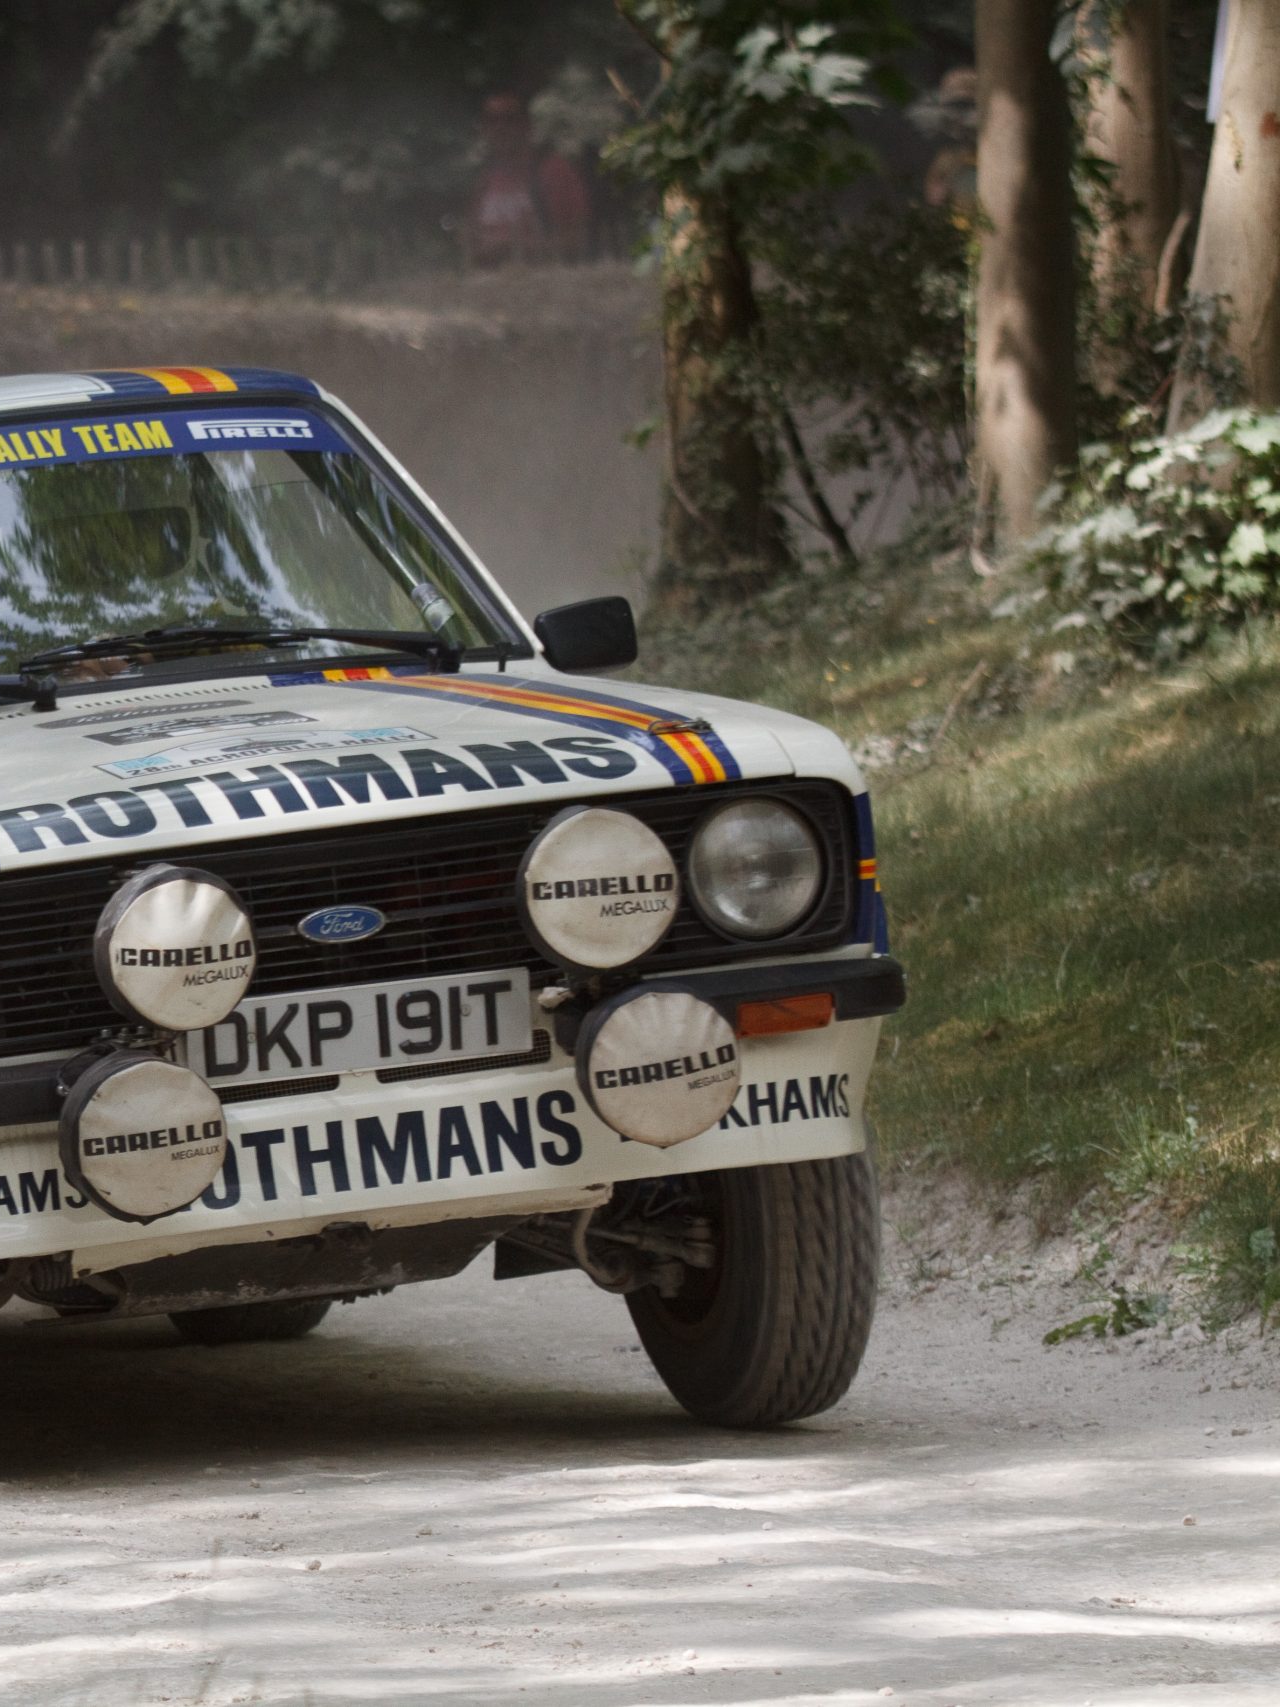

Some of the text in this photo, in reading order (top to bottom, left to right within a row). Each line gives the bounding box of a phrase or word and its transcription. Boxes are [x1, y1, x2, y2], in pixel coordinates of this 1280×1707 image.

[72, 420, 173, 455] TEAM
[186, 419, 314, 440] PIRELLI
[189, 742, 334, 766] ACROPOLIS
[343, 734, 419, 747] RALLY
[532, 873, 674, 901] CARELLO
[600, 898, 671, 918] MEGALUX
[320, 912, 365, 934] Ford
[120, 940, 253, 968] CARELLO
[183, 963, 250, 987] MEGALUX
[204, 980, 512, 1077] DKP 191T
[595, 1043, 736, 1089] CARELLO
[687, 1069, 736, 1093] MEGALUX
[83, 1120, 222, 1156] CARELLO
[175, 1090, 582, 1212] OTHMANS
[171, 1144, 221, 1162] MEGALUX
